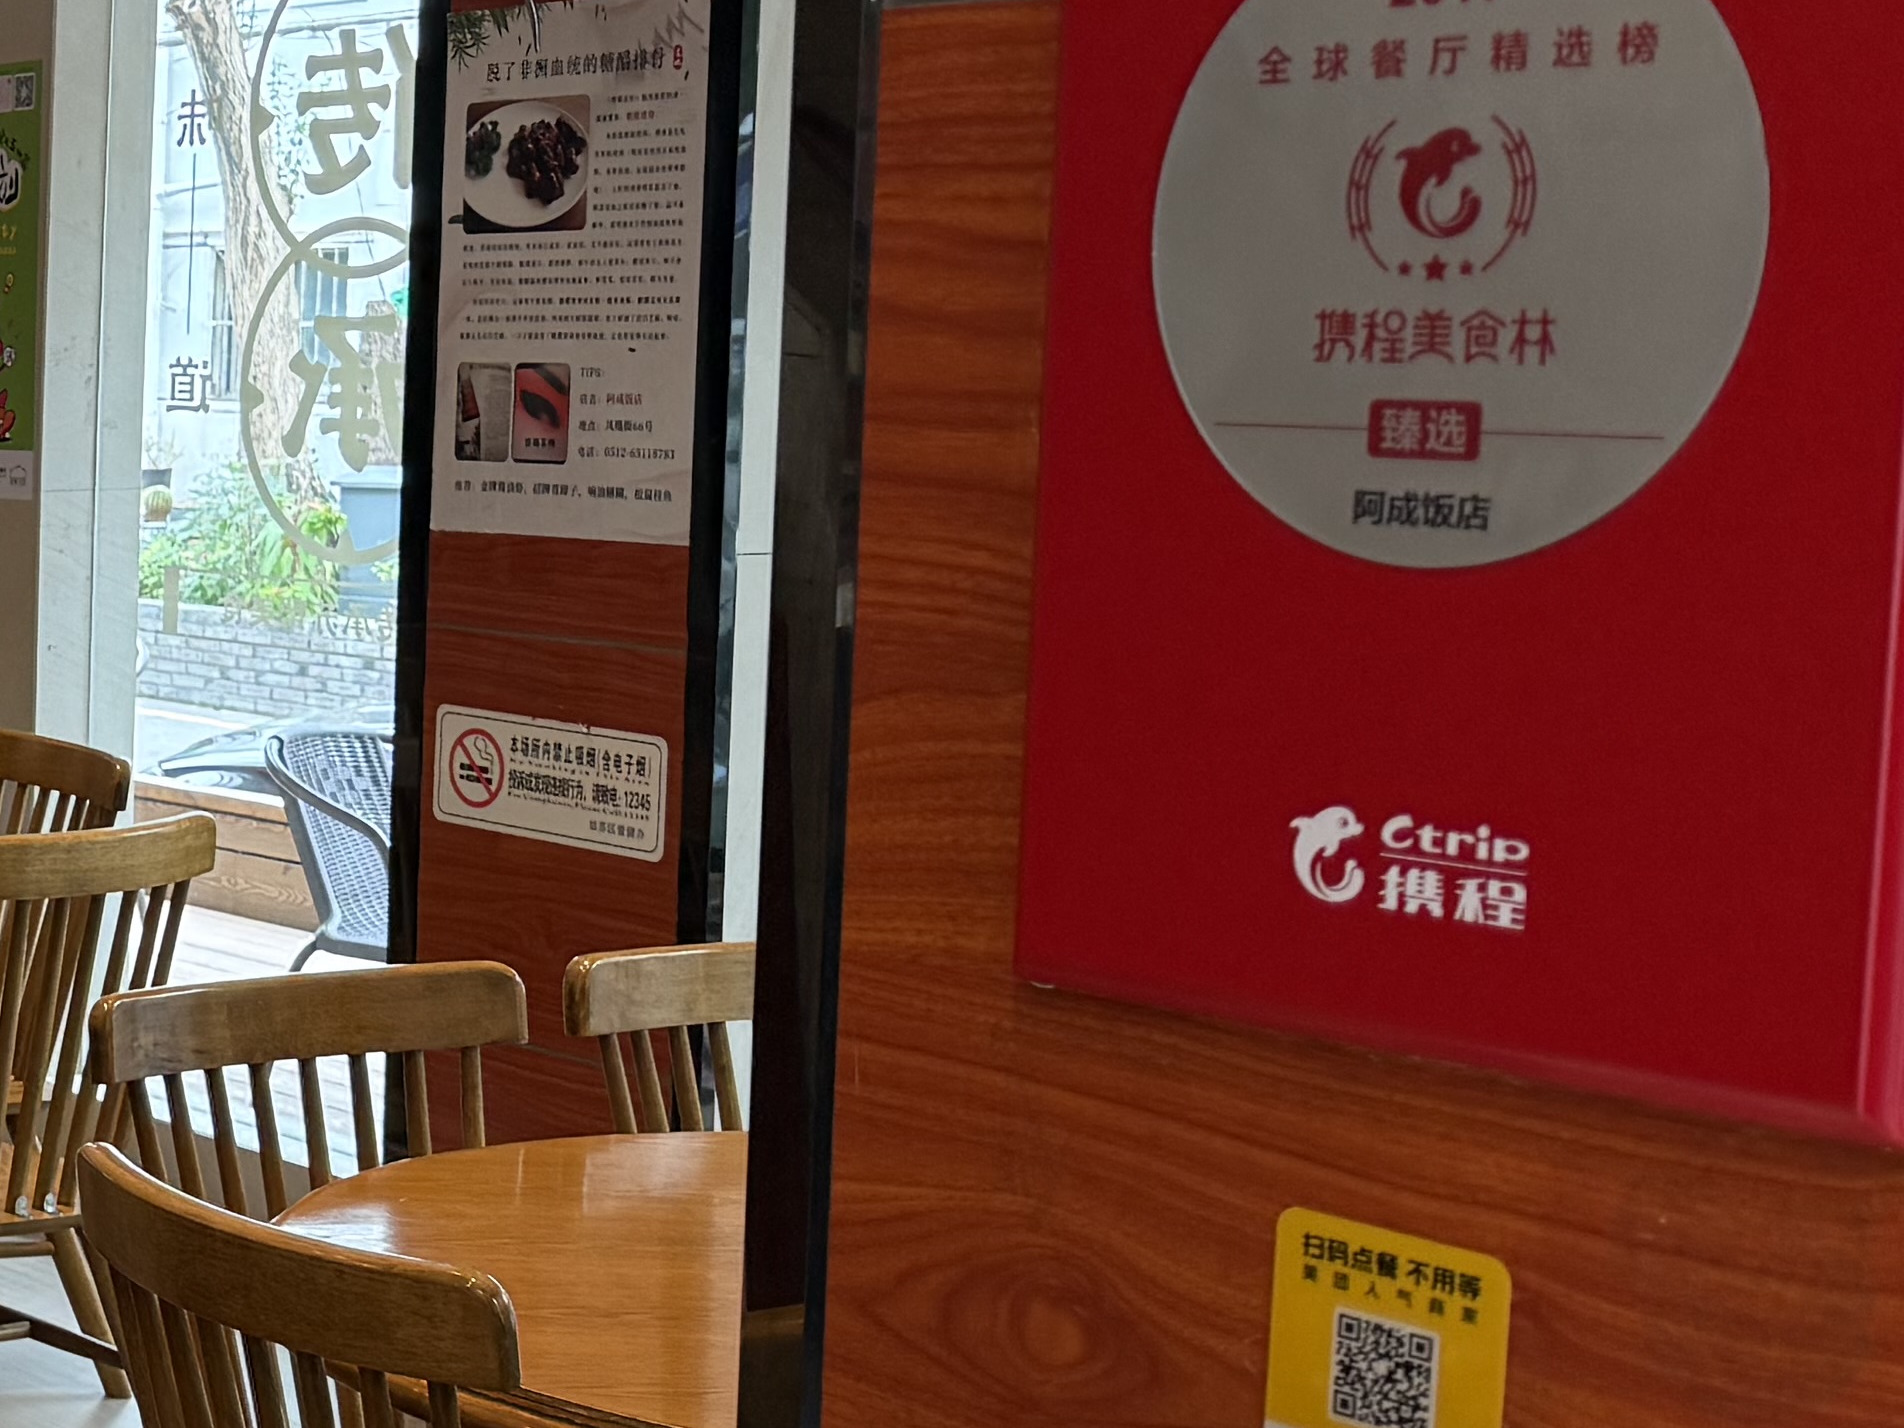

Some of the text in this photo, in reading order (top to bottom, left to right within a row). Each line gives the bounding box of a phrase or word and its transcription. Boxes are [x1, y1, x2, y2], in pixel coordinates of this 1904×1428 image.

[1256, 20, 1661, 85] 全球餐厅精选榜
[1312, 308, 1559, 366] 携程美食林
[1379, 409, 1468, 454] 臻选
[1352, 489, 1490, 532] 阿成饭店
[1379, 813, 1531, 863] Ctrip
[1377, 864, 1528, 931] 携程
[1300, 1232, 1483, 1302] 扫码点餐 不用等
